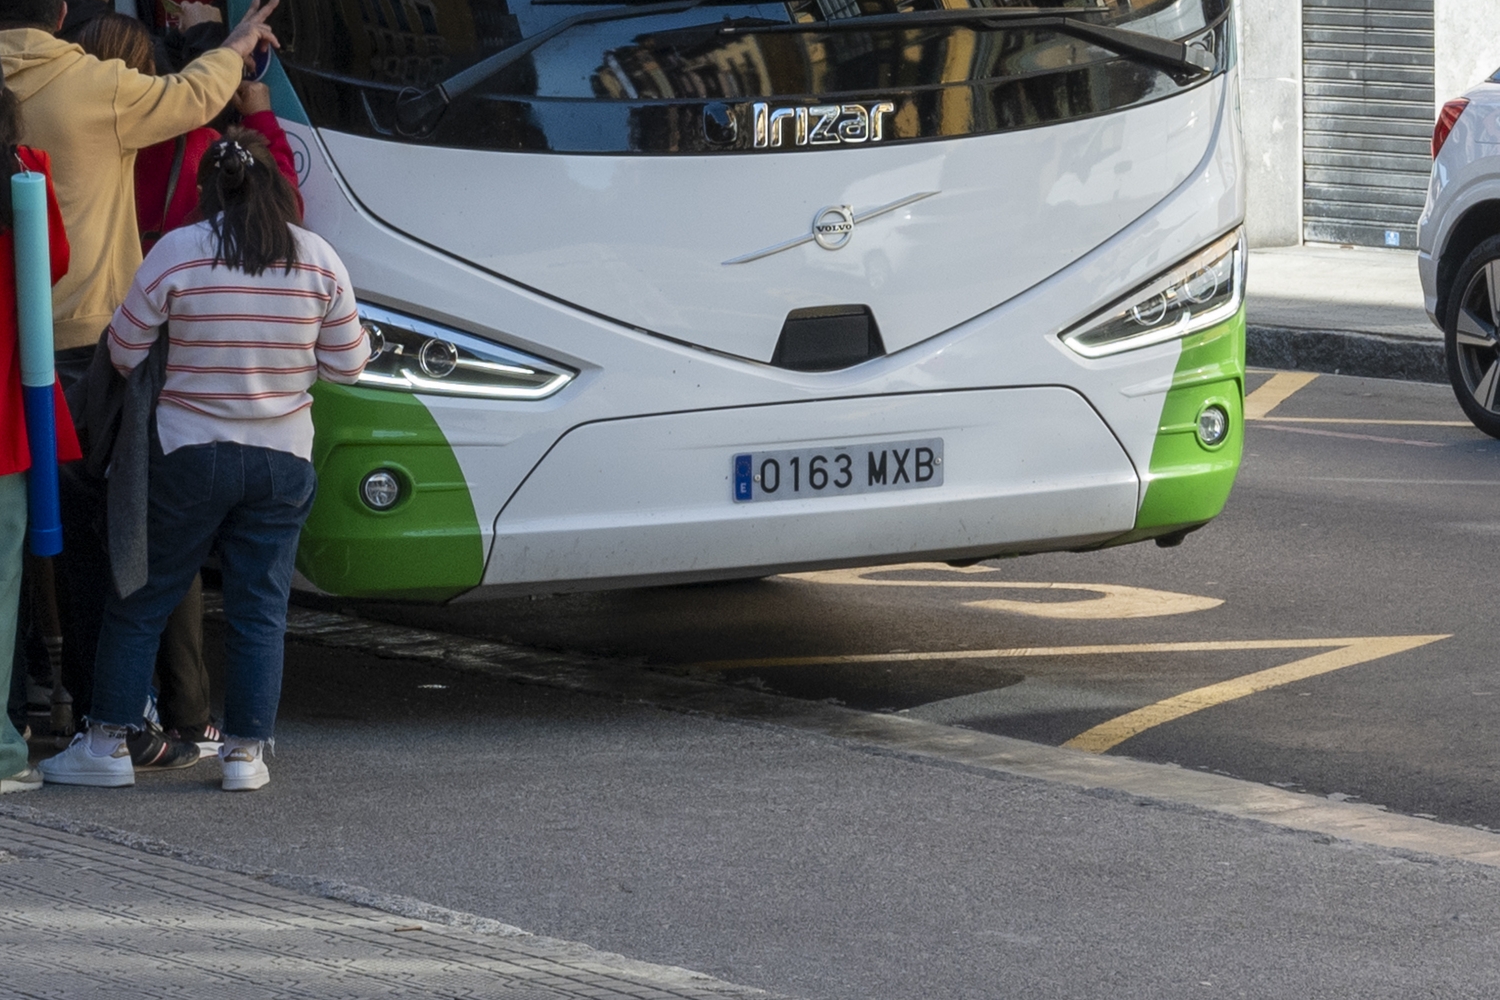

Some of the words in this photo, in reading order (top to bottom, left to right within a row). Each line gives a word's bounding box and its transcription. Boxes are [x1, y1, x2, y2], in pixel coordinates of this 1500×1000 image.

[816, 224, 852, 233] VOLVO
[740, 482, 747, 494] E
[759, 453, 853, 494] 0163
[867, 447, 935, 487] MXB
